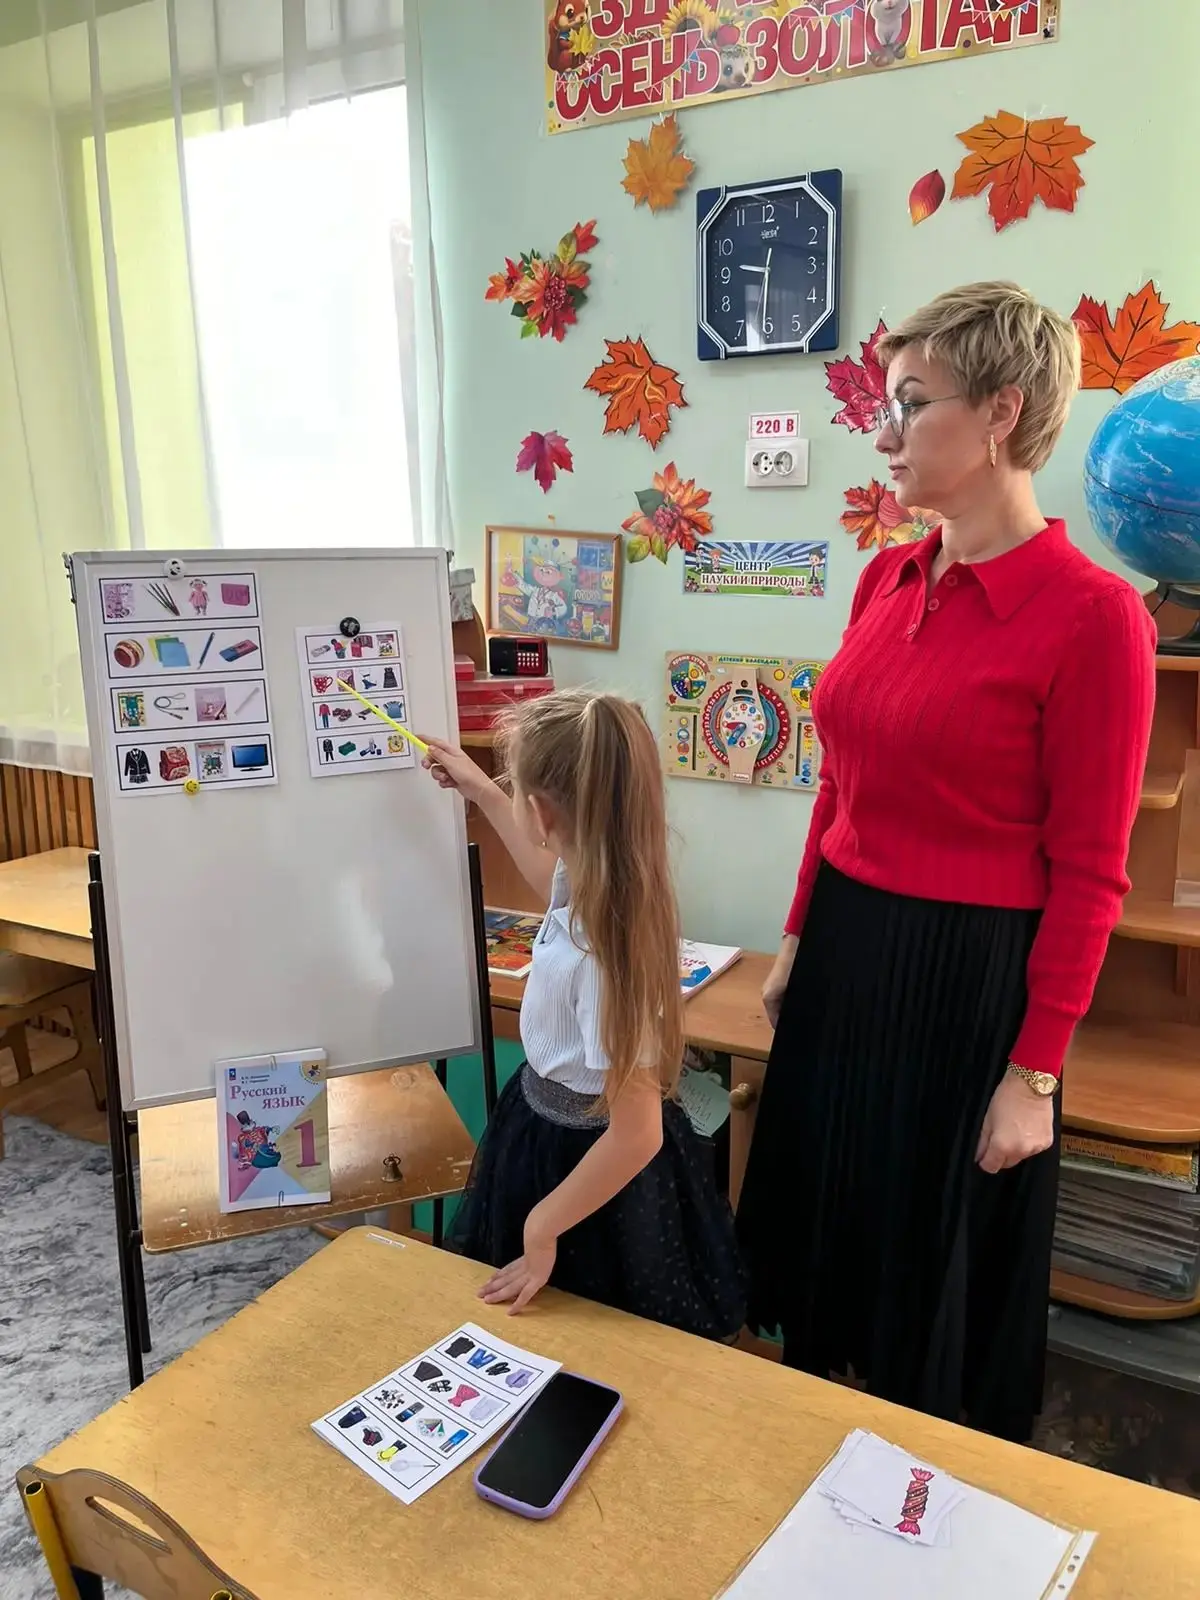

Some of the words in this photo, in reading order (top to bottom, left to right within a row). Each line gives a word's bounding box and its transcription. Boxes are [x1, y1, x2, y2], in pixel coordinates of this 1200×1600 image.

[555, 29, 722, 120] ОСЕНЬ
[736, 209, 745, 226] 11
[762, 204, 775, 223] 12
[795, 201, 799, 218] 1
[808, 227, 818, 245] 2
[718, 238, 733, 256] 10
[807, 256, 817, 274] 3
[720, 267, 731, 284] 9
[806, 286, 817, 303] 4
[721, 295, 731, 312] 8
[735, 320, 744, 337] 7
[763, 317, 773, 334] 6
[791, 314, 800, 331] 5
[756, 419, 780, 433] 220
[735, 561, 771, 572] ЦЕНТР
[702, 574, 739, 584] НАУКИ
[740, 576, 748, 584] И
[750, 576, 805, 587] ПРИРОДЫ
[230, 1085, 287, 1100] Русский
[262, 1096, 305, 1110] язык
[294, 1118, 321, 1168] 1
